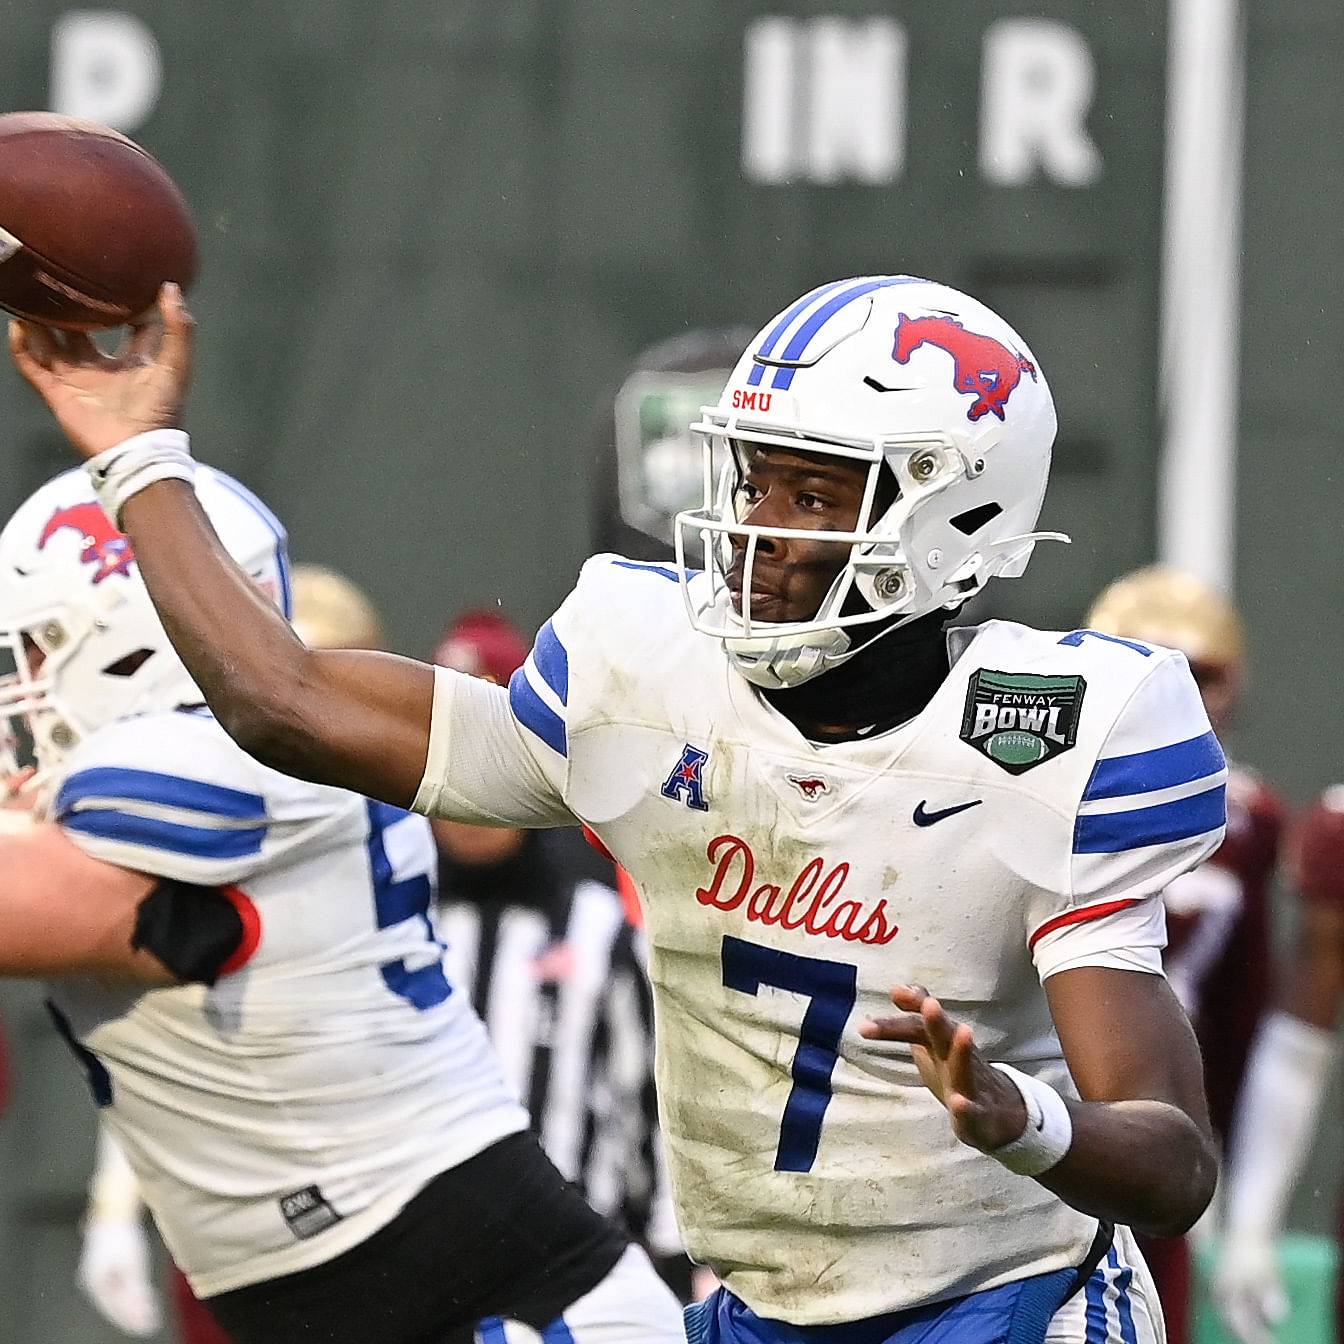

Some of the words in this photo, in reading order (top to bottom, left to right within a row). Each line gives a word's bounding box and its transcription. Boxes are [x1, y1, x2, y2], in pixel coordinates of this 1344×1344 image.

[742, 14, 908, 184] IN
[979, 20, 1102, 186] R
[732, 389, 773, 412] SMU
[970, 703, 1065, 745] BOWL
[993, 694, 1057, 706] FENWAY
[696, 834, 900, 945] Dallas
[720, 934, 858, 1174] 7
